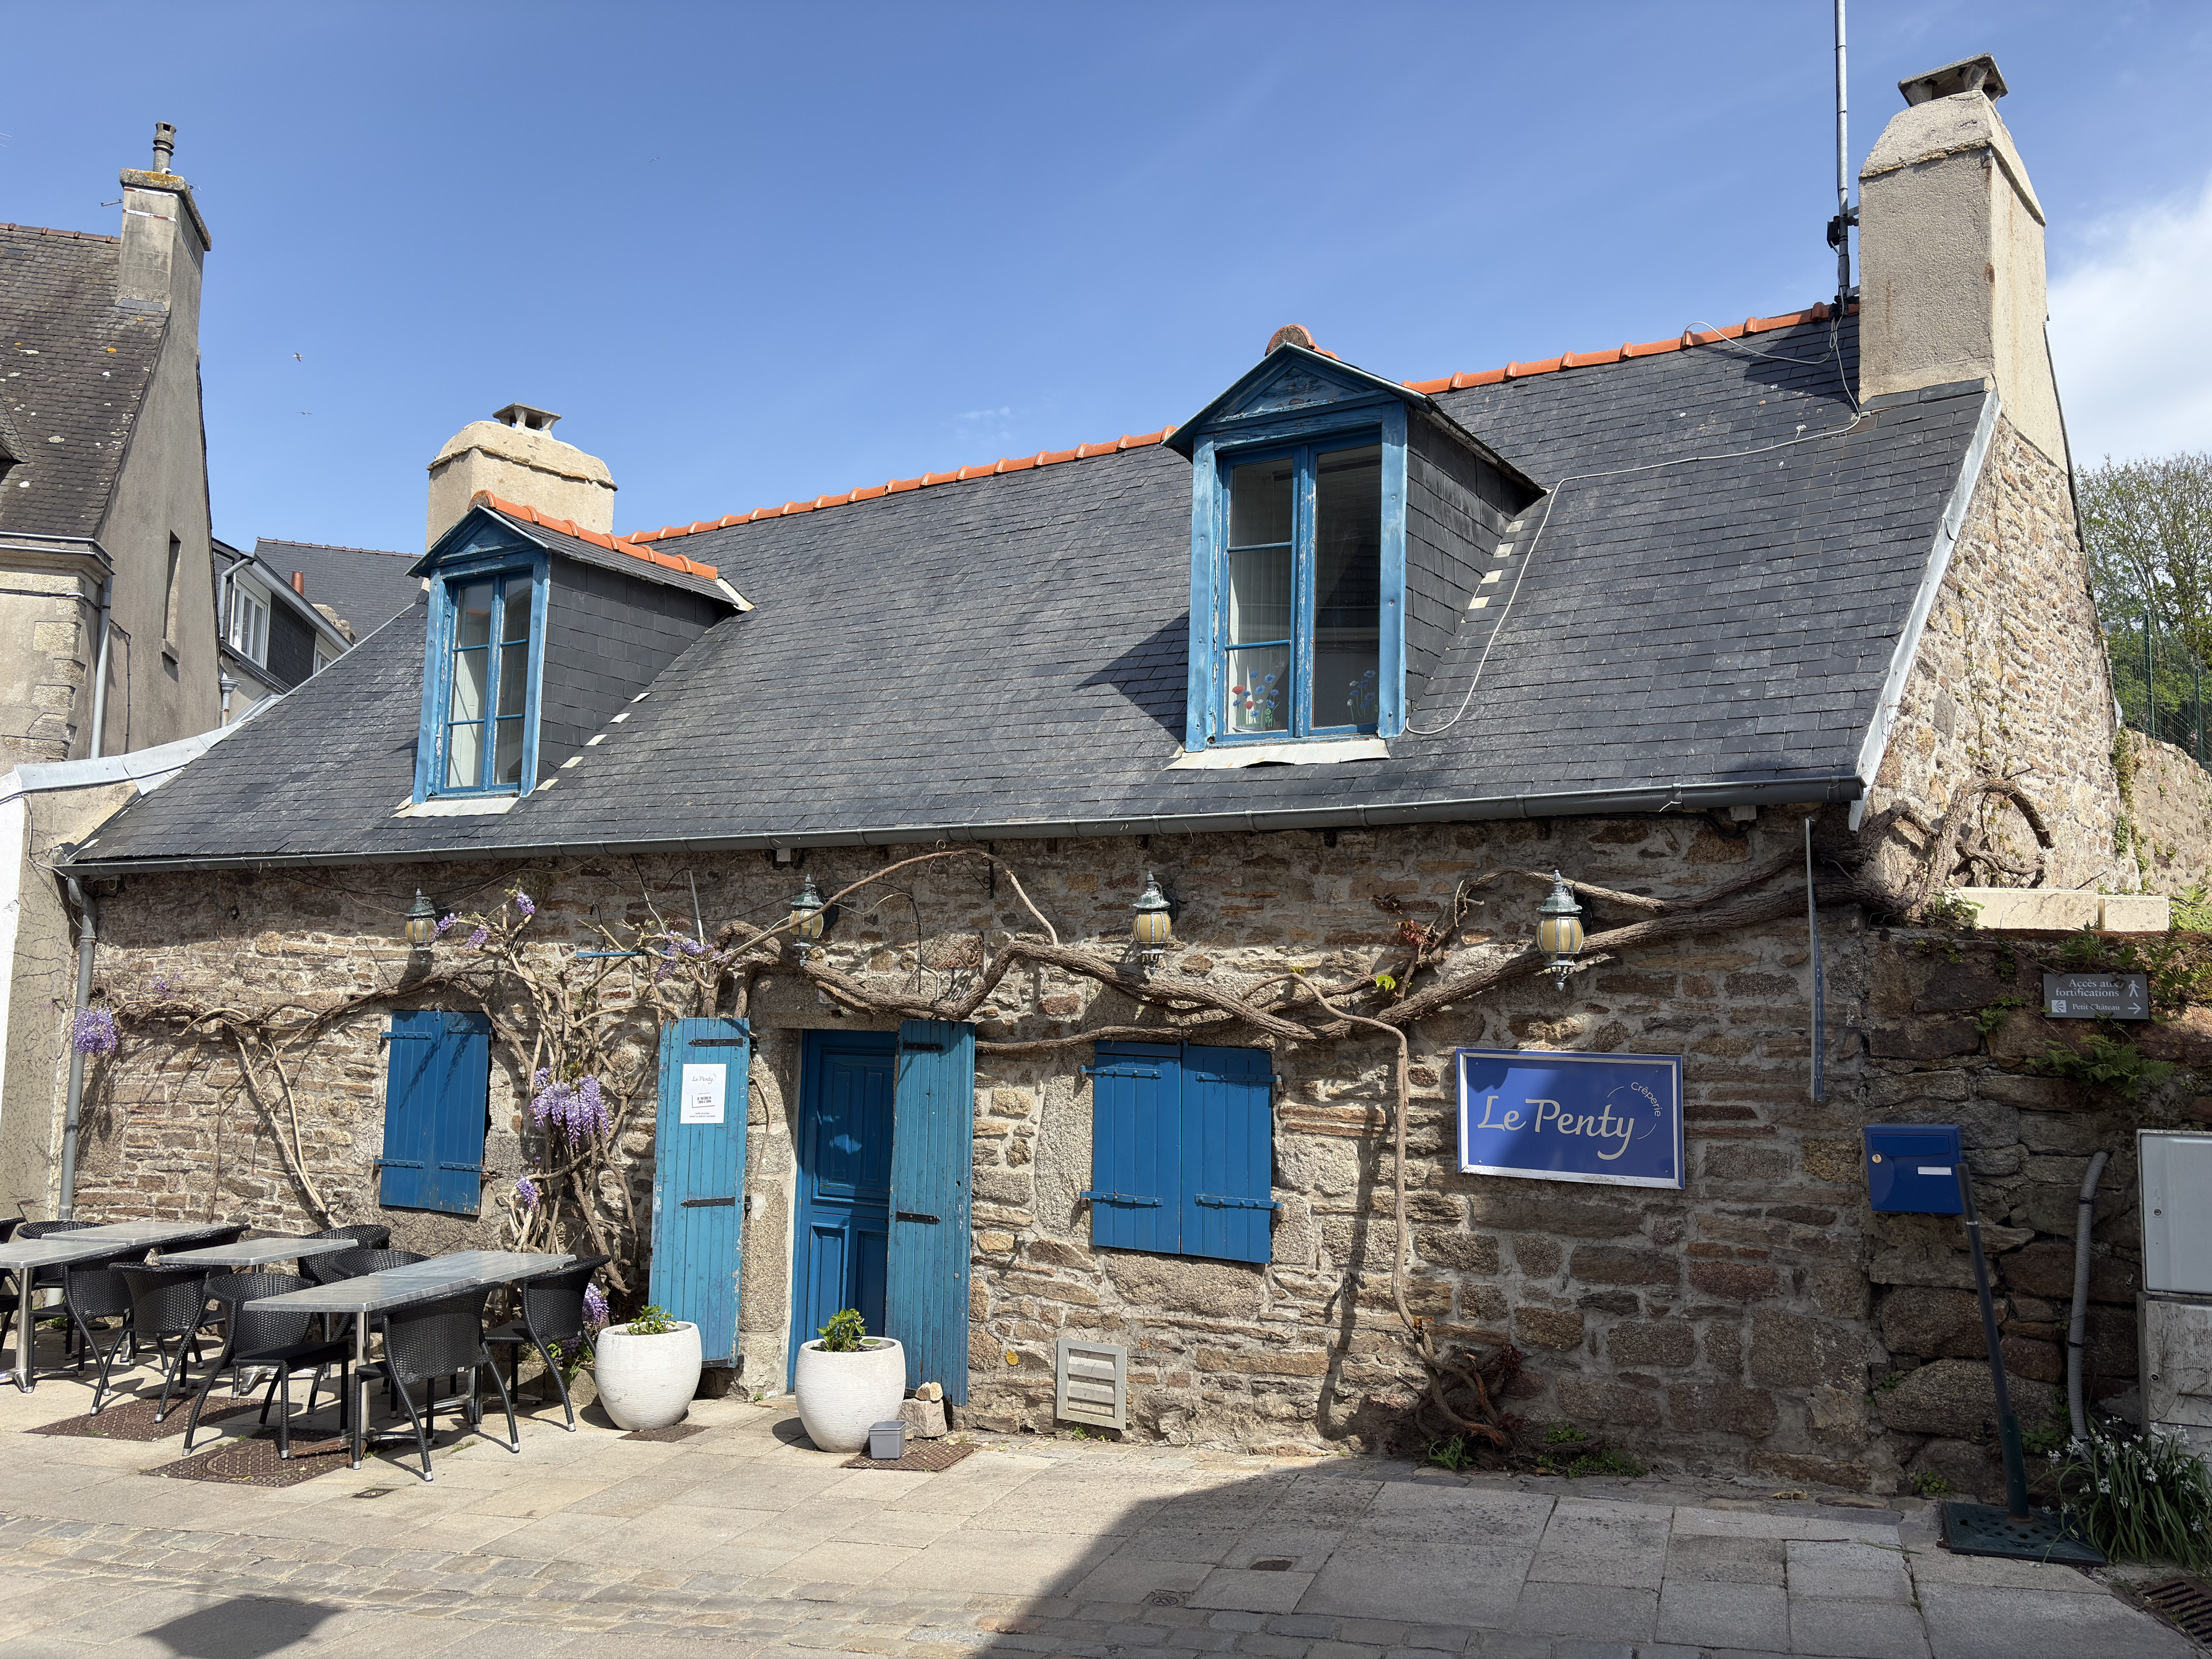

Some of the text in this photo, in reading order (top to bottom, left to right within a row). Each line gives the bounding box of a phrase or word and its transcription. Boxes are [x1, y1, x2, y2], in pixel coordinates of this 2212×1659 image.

[2056, 987, 2120, 997] fortifications
[2069, 979, 2096, 988] Accès
[1631, 1082, 1662, 1117] Crêperie
[1477, 1095, 1635, 1160] Le Penty
